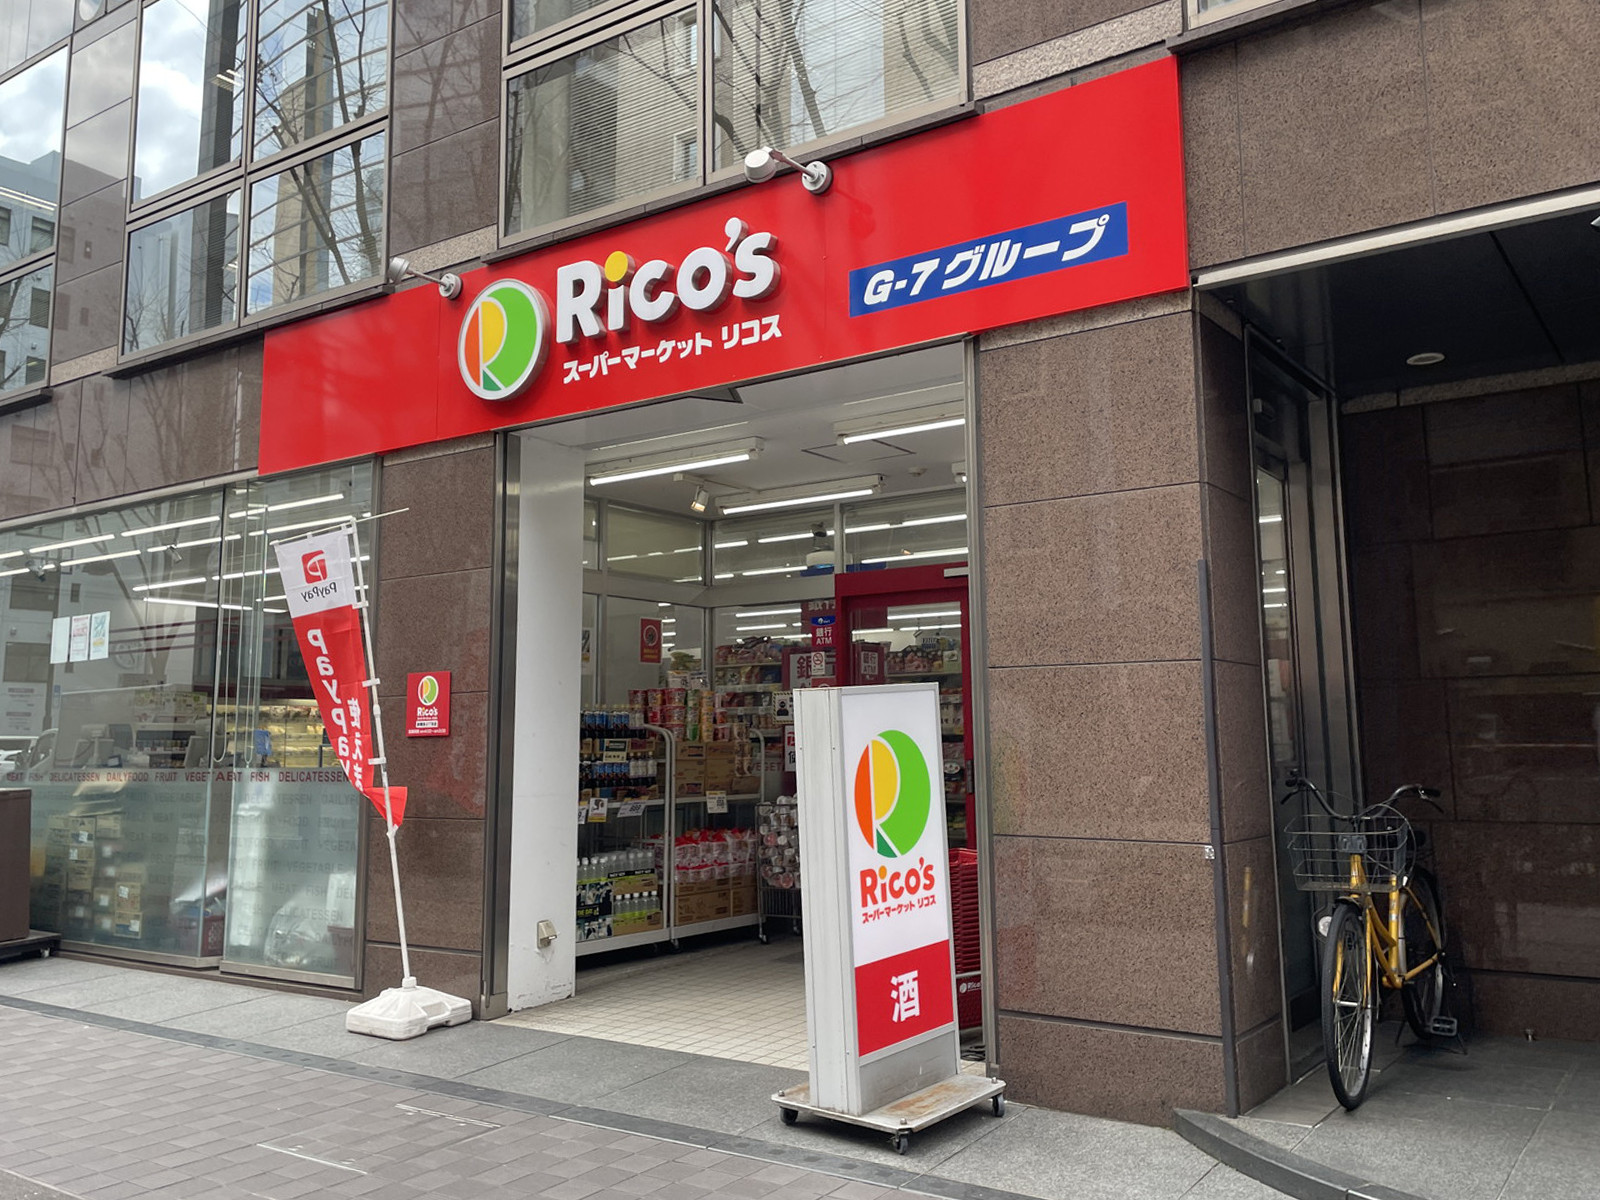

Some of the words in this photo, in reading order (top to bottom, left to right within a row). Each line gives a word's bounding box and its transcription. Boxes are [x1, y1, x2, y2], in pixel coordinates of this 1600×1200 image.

[556, 217, 780, 345] Rico's
[563, 332, 713, 384] スーパーマーケット
[721, 314, 783, 349] リコス
[816, 627, 832, 637] 銀行
[816, 637, 832, 645] ATM
[417, 706, 438, 717] Rico's
[49, 772, 100, 782] DELICATESSEN
[106, 772, 149, 783] DAILYFOOD
[155, 772, 177, 782] FRUIT
[251, 772, 270, 783] FISH
[278, 772, 350, 783] DELICATESSEN
[860, 857, 935, 908] Rico's
[862, 900, 915, 924] スーパーマーケット
[917, 895, 936, 909] リコス
[890, 970, 920, 1023] 酒
